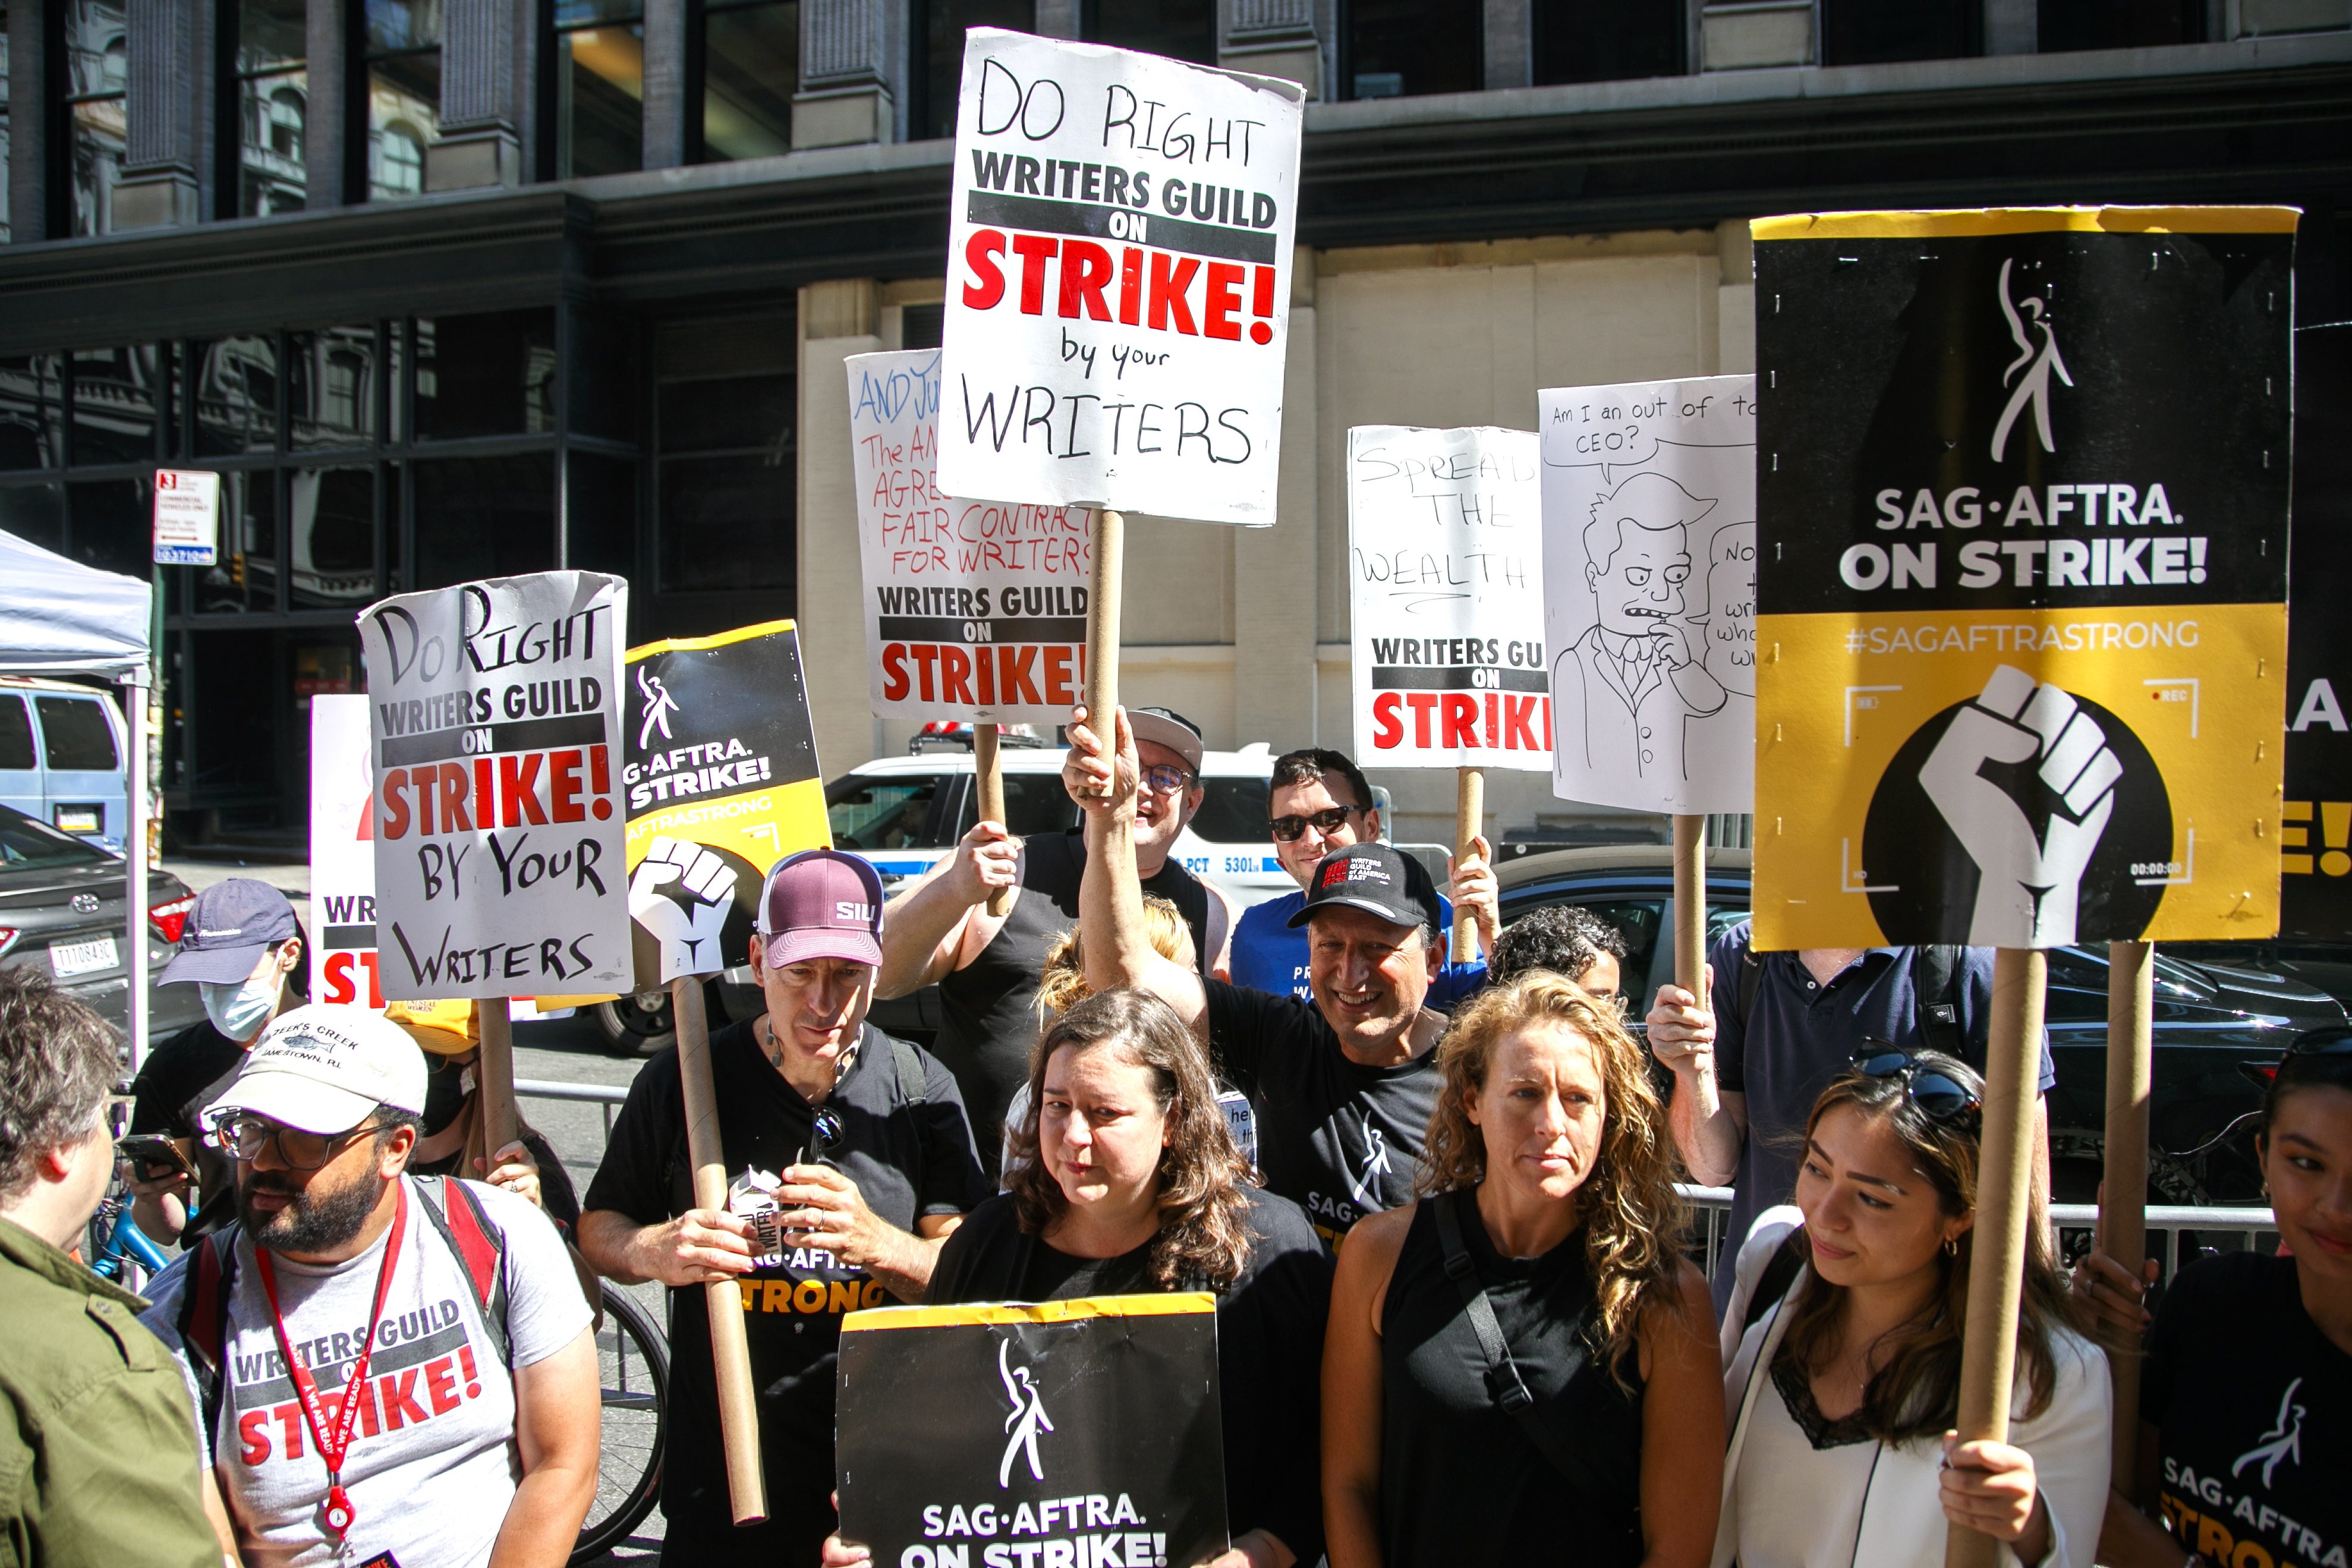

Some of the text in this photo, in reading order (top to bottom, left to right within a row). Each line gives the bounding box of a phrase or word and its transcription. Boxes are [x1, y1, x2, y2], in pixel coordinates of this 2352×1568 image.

[977, 56, 1266, 166] DO RIGHT
[971, 149, 1277, 229] WRITERS GUILD
[1109, 211, 1146, 243] ON
[962, 229, 1276, 345] STRIKE!
[1062, 327, 1170, 380] by your
[961, 373, 1252, 464] WRITERS
[1581, 405, 1591, 424] I
[1601, 407, 1621, 420] an
[1631, 398, 1668, 418] out
[1682, 395, 1714, 418] of
[861, 434, 903, 468] The
[1576, 425, 1639, 455] CEO?
[1357, 448, 1535, 493] SPREAD
[873, 469, 952, 508] AGRE
[882, 506, 954, 547] FAIR
[1412, 493, 1513, 527] THE
[892, 547, 950, 574] FOR
[1353, 548, 1526, 589] WEALTH
[1839, 536, 2208, 591] ON STRIKE!
[877, 586, 1088, 616] WRITERS GUILD
[963, 621, 991, 642] ON
[1844, 619, 2200, 656] #SAGAFTRASTRONG
[1371, 637, 1498, 665] WRITERS
[1472, 667, 1500, 689] ON
[380, 676, 602, 737] WRITERS GUILD
[2162, 689, 2187, 703] REC
[462, 728, 493, 754] ON
[383, 745, 613, 840] STRIKE!
[631, 756, 772, 810] STRIKE!
[418, 842, 470, 901] BY
[1186, 858, 1209, 873] PCT
[1351, 858, 1381, 867] WRITERS
[1358, 869, 1391, 880] AMERICA
[1853, 870, 1867, 879] HD
[2130, 862, 2181, 877] 00:00:00
[836, 902, 876, 922] SIU
[392, 921, 595, 988] WRITERS
[272, 1022, 358, 1050] ZEEK'S CREEK
[237, 1327, 367, 1383] WRTERS
[377, 1299, 459, 1346] GUILD
[313, 1409, 326, 1428] ARE
[342, 1409, 354, 1428] ARE
[348, 1377, 362, 1408] READY
[319, 1427, 334, 1454] READY
[900, 1532, 1169, 1568] ON STRIKE!
